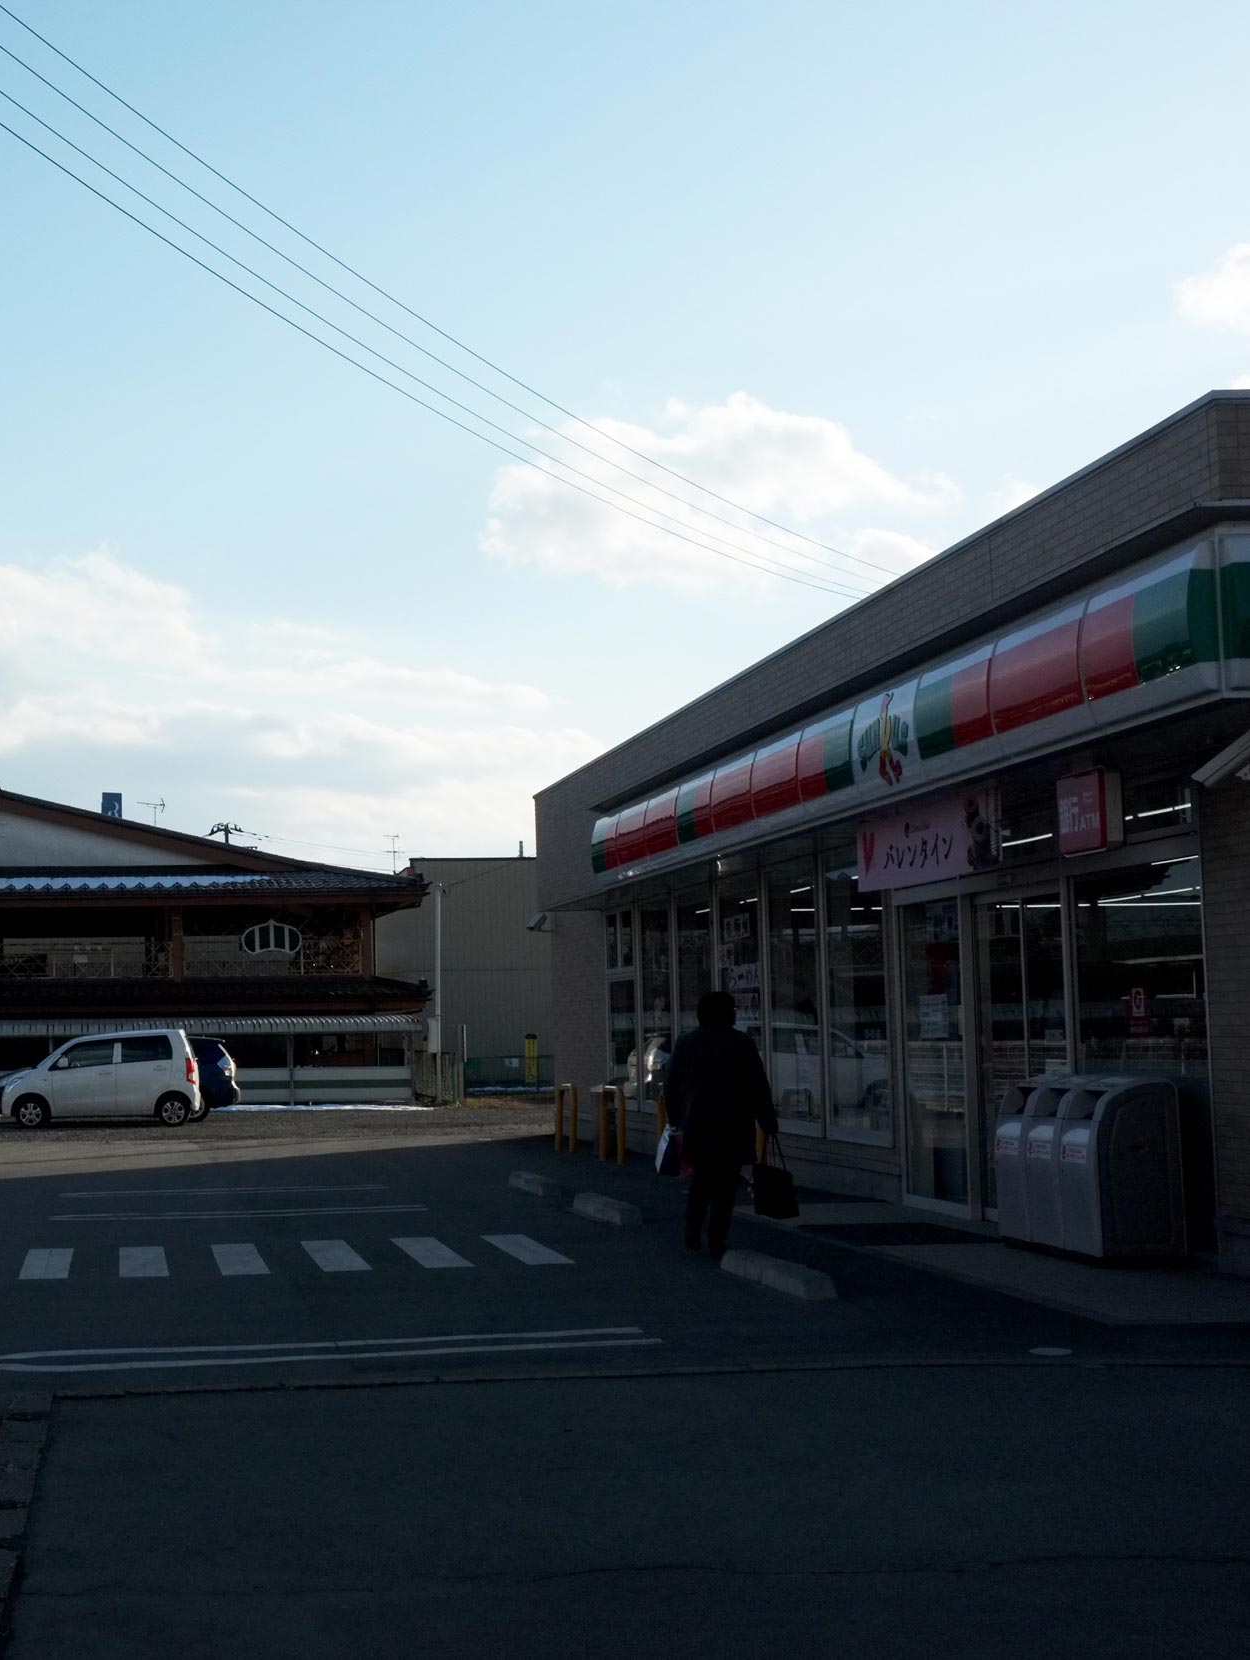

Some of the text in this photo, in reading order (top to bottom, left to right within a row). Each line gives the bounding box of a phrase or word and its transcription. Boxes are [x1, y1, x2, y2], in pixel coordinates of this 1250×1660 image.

[884, 833, 953, 869] バレンタイン
